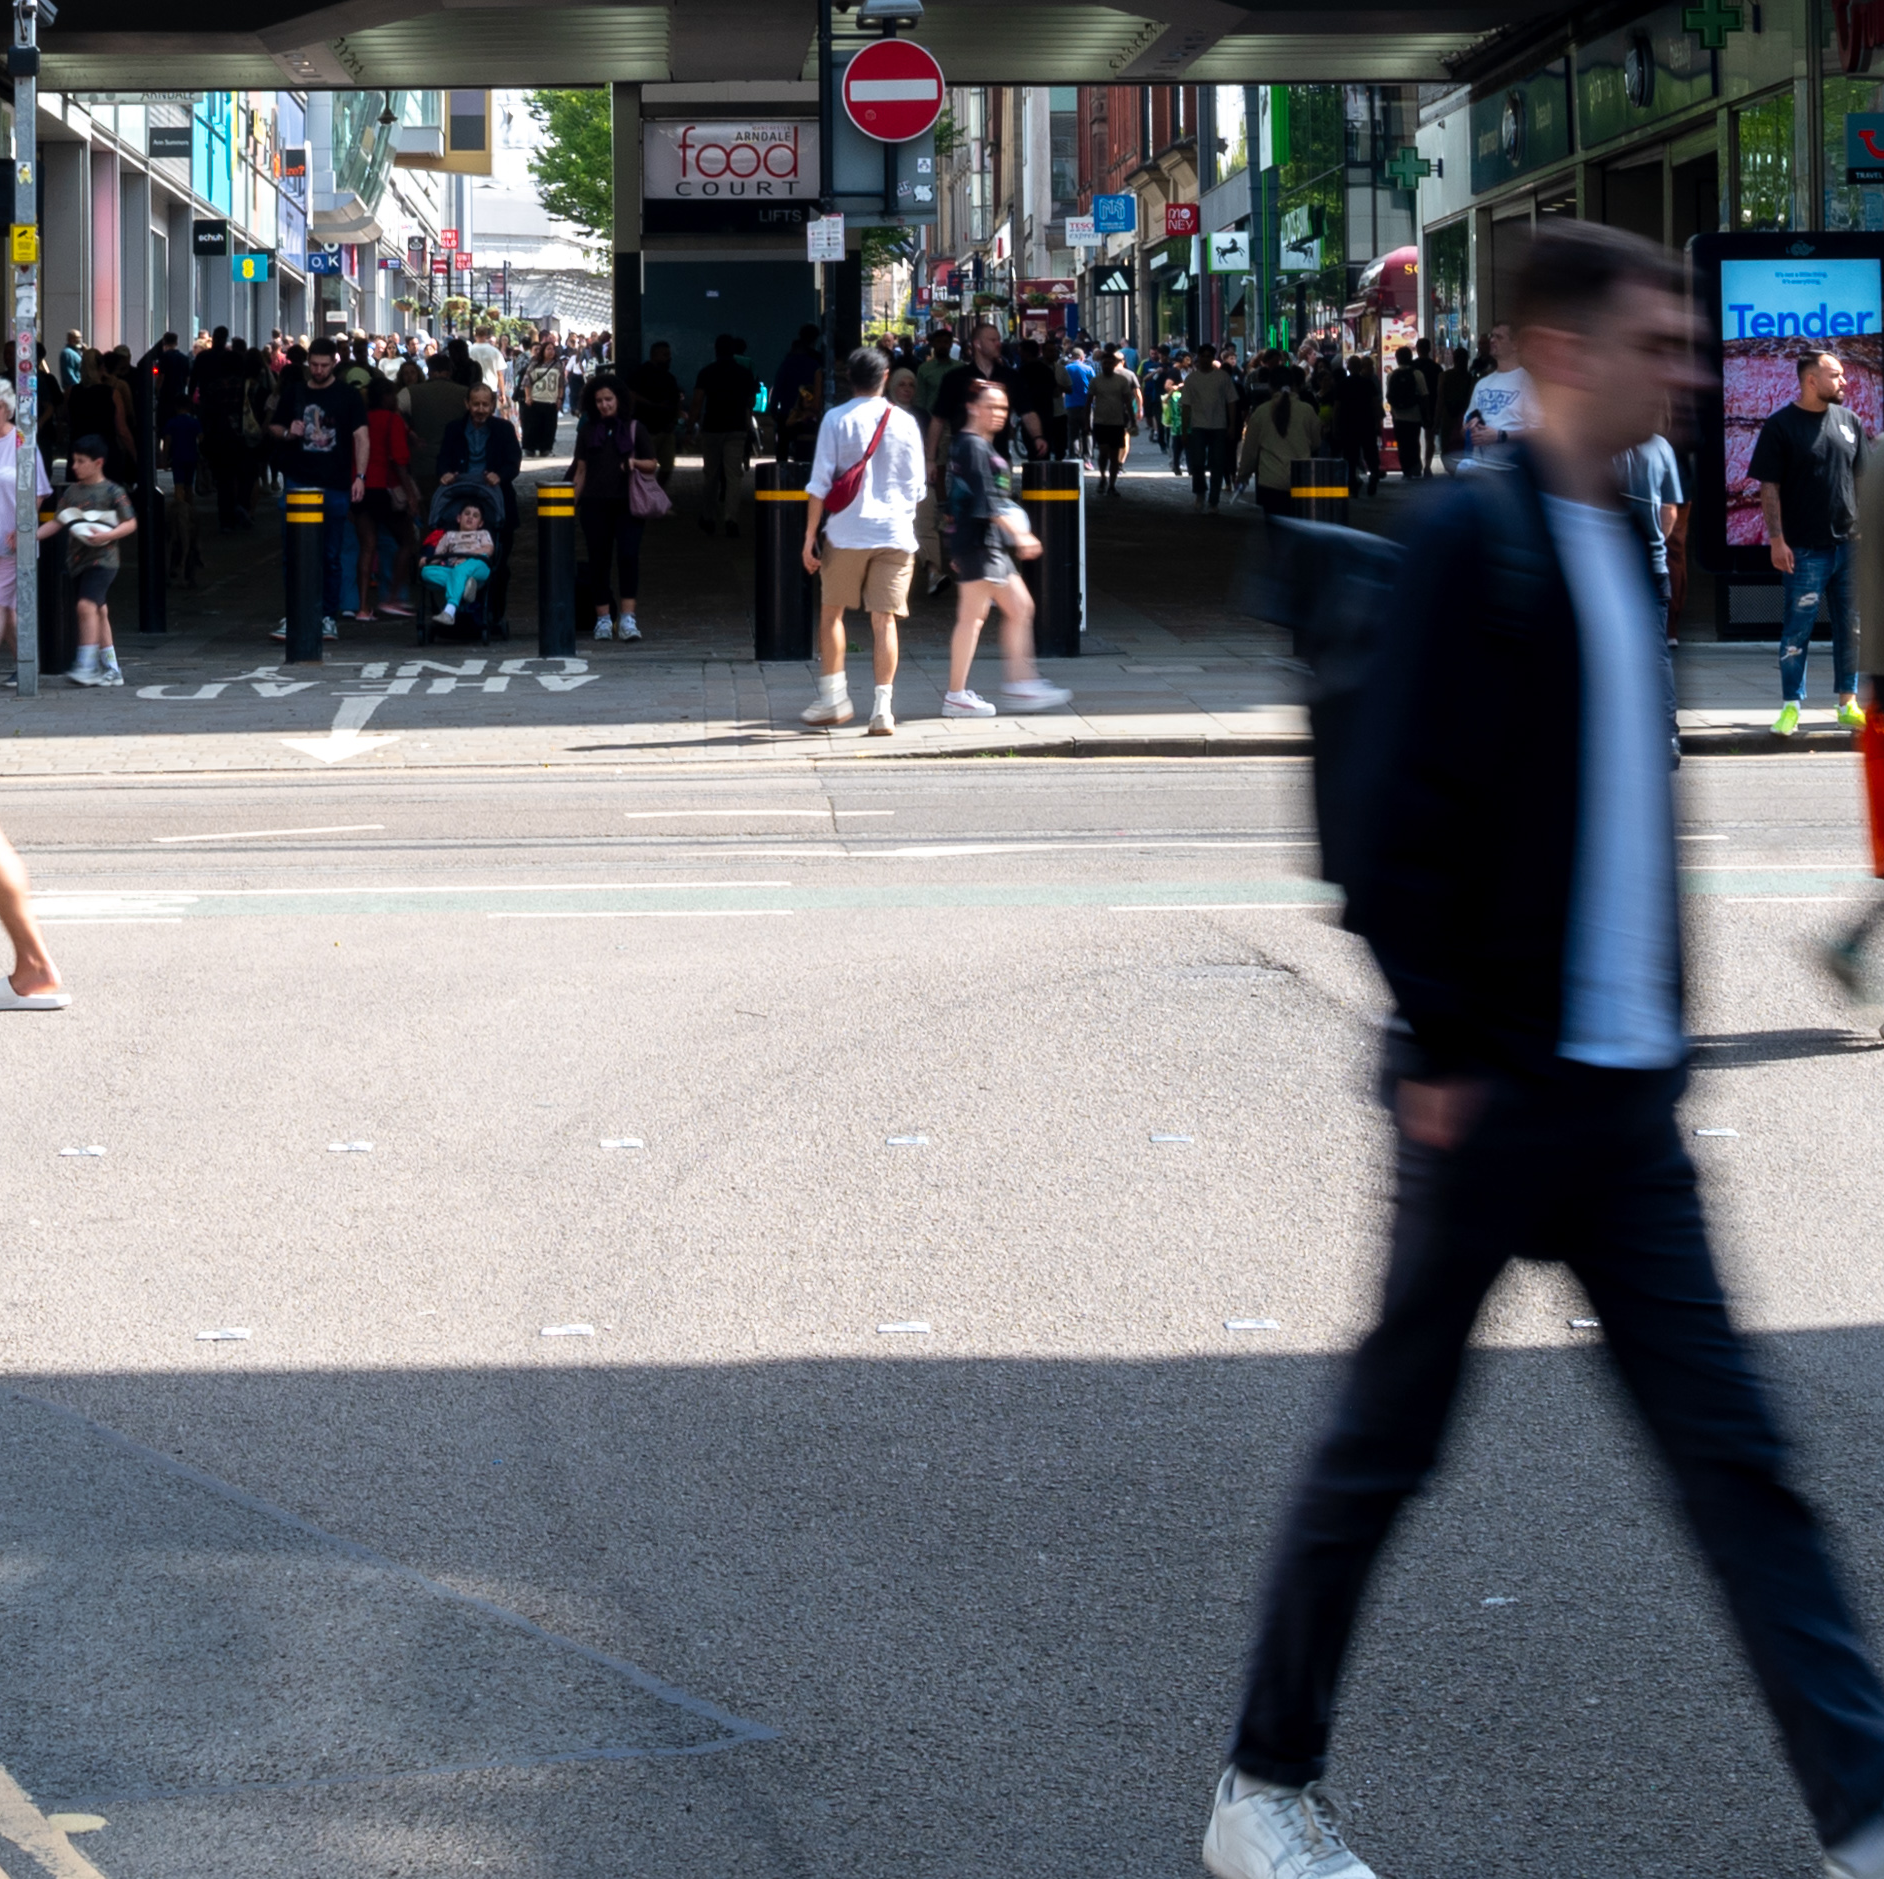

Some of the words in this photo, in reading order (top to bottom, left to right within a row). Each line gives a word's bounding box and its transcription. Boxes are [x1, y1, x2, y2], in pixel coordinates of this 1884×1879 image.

[734, 131, 792, 143] ARNDALE
[678, 126, 799, 179] food
[1855, 171, 1882, 180] TRAVEL
[675, 181, 800, 197] COURT
[759, 209, 802, 222] LIFTS
[198, 233, 224, 242] schuh
[1728, 302, 1875, 338] Tender
